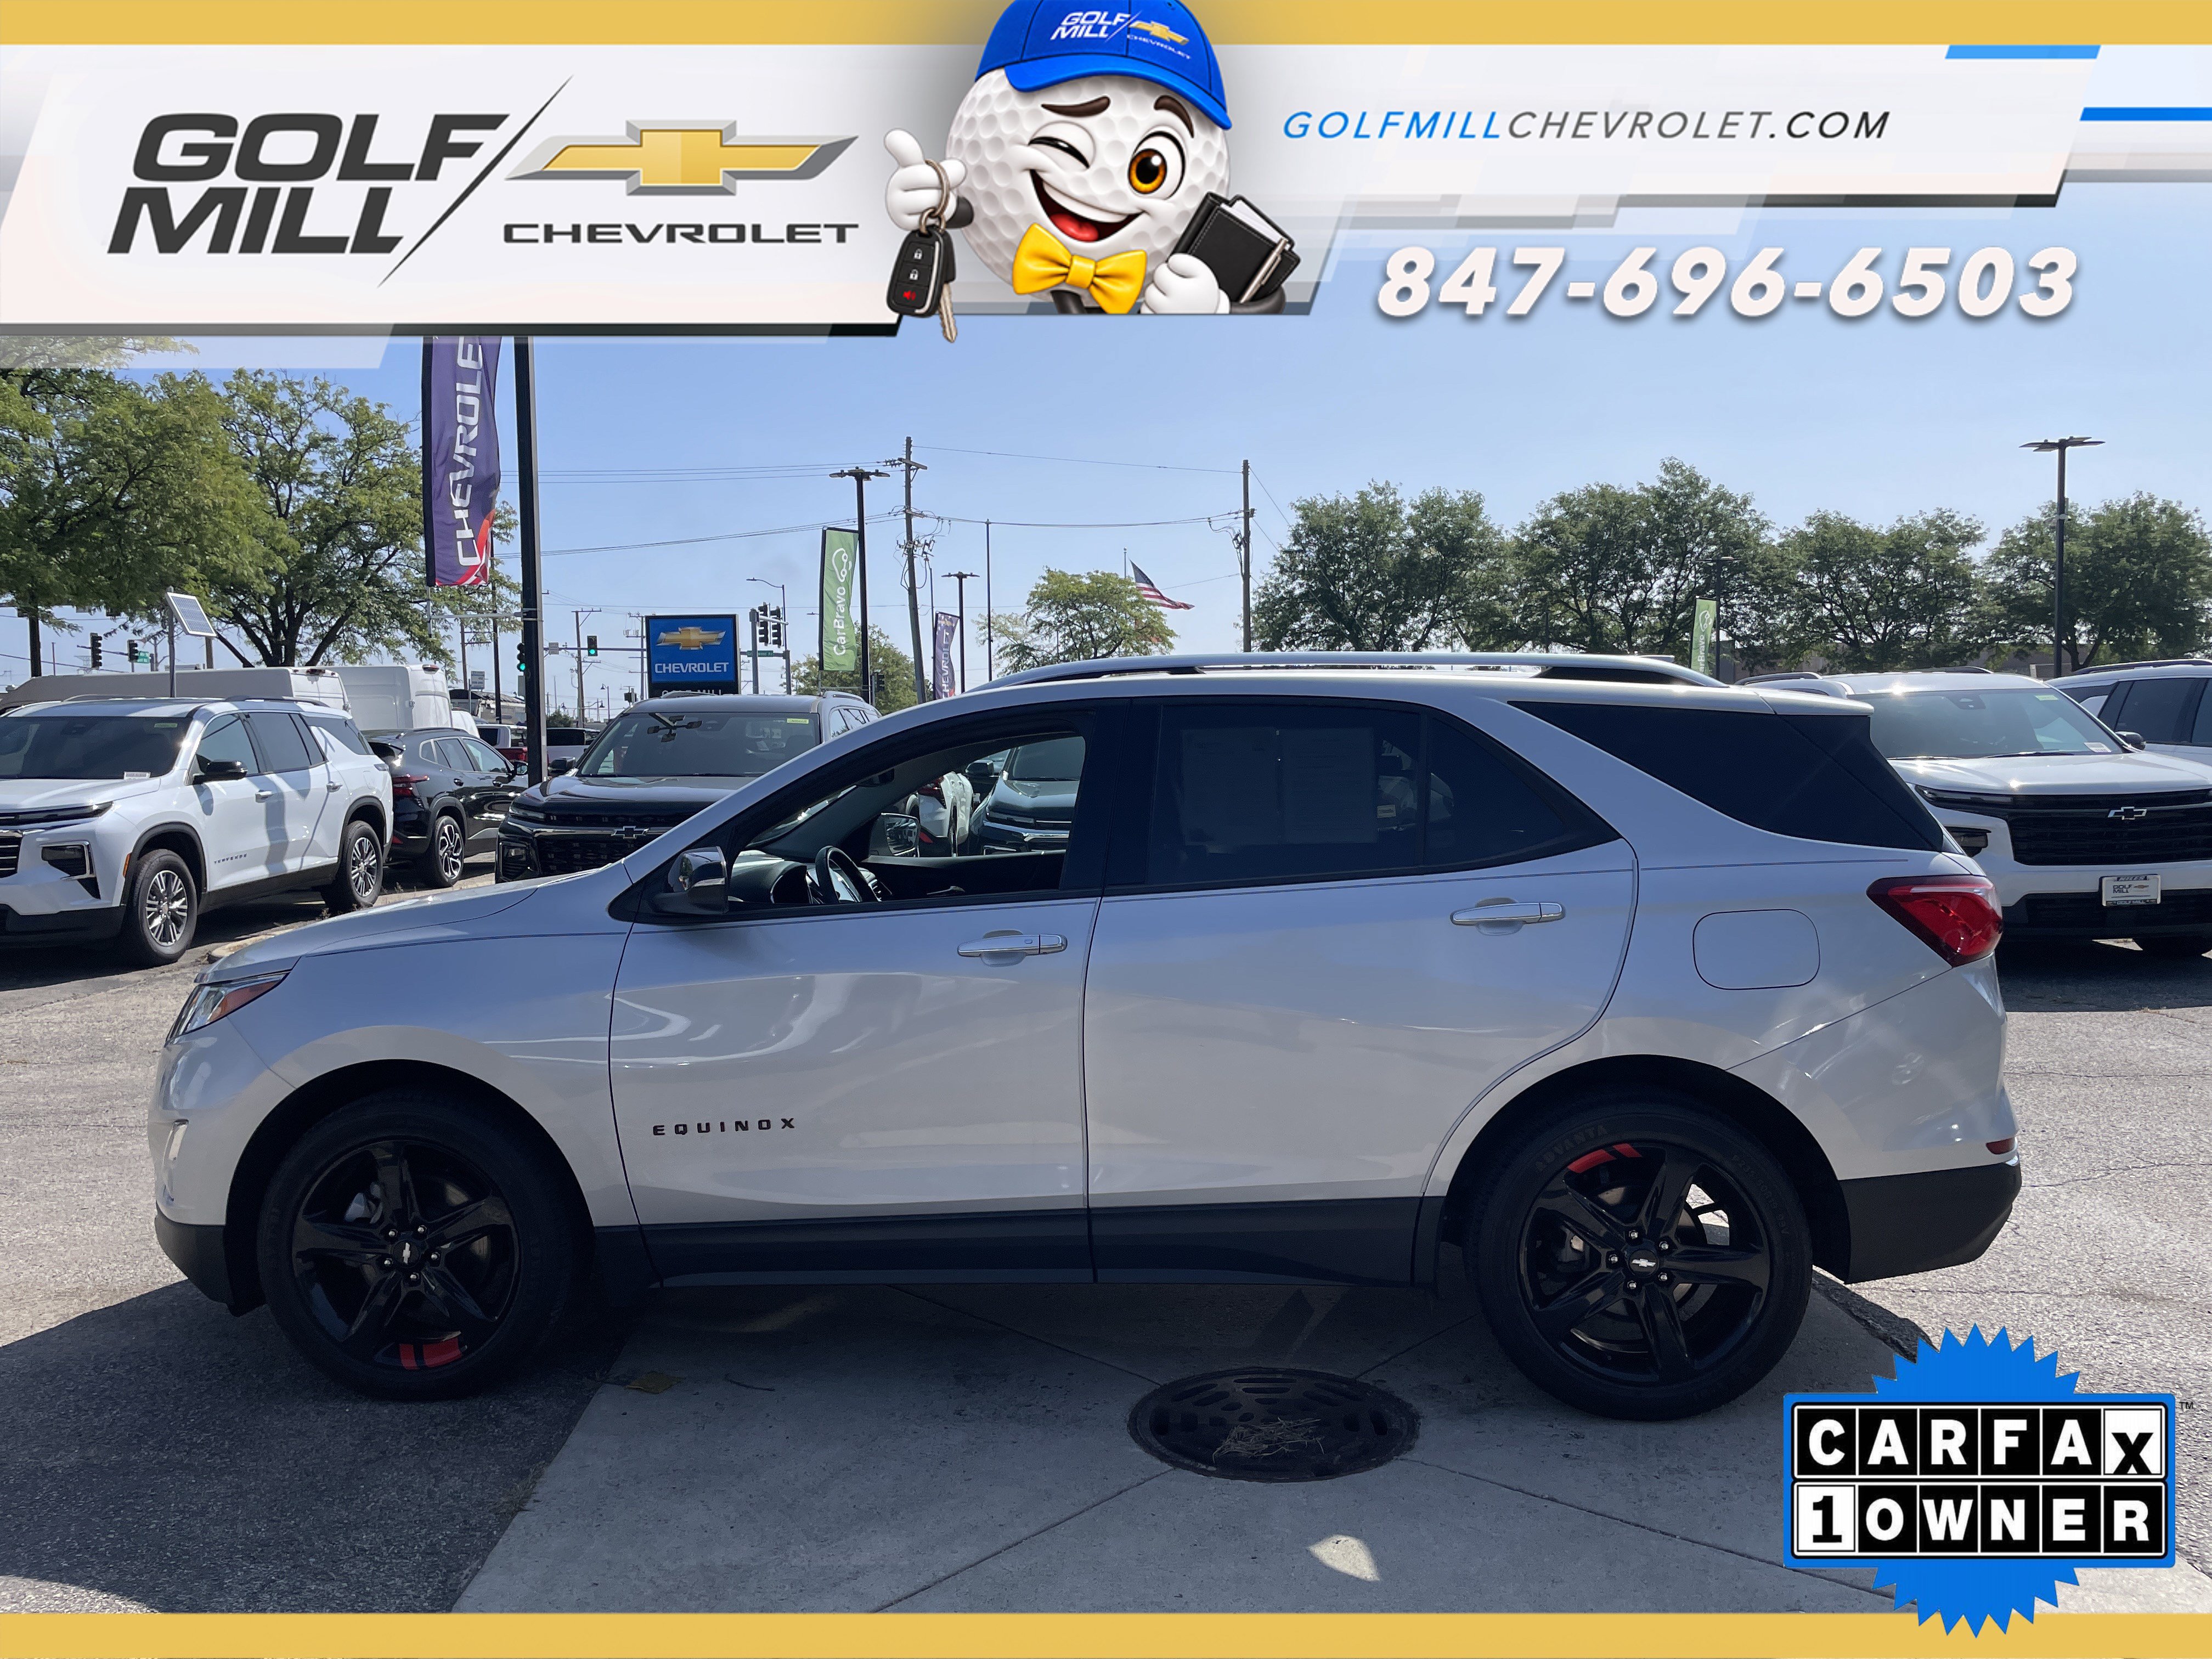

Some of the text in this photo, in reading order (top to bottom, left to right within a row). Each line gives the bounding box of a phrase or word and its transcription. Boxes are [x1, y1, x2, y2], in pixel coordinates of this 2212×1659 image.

[449, 336, 483, 566] CHEVROLE
[833, 586, 847, 656] CarBravo
[654, 662, 729, 674] CHEVROLET
[652, 1118, 795, 1136] EQUINOX
